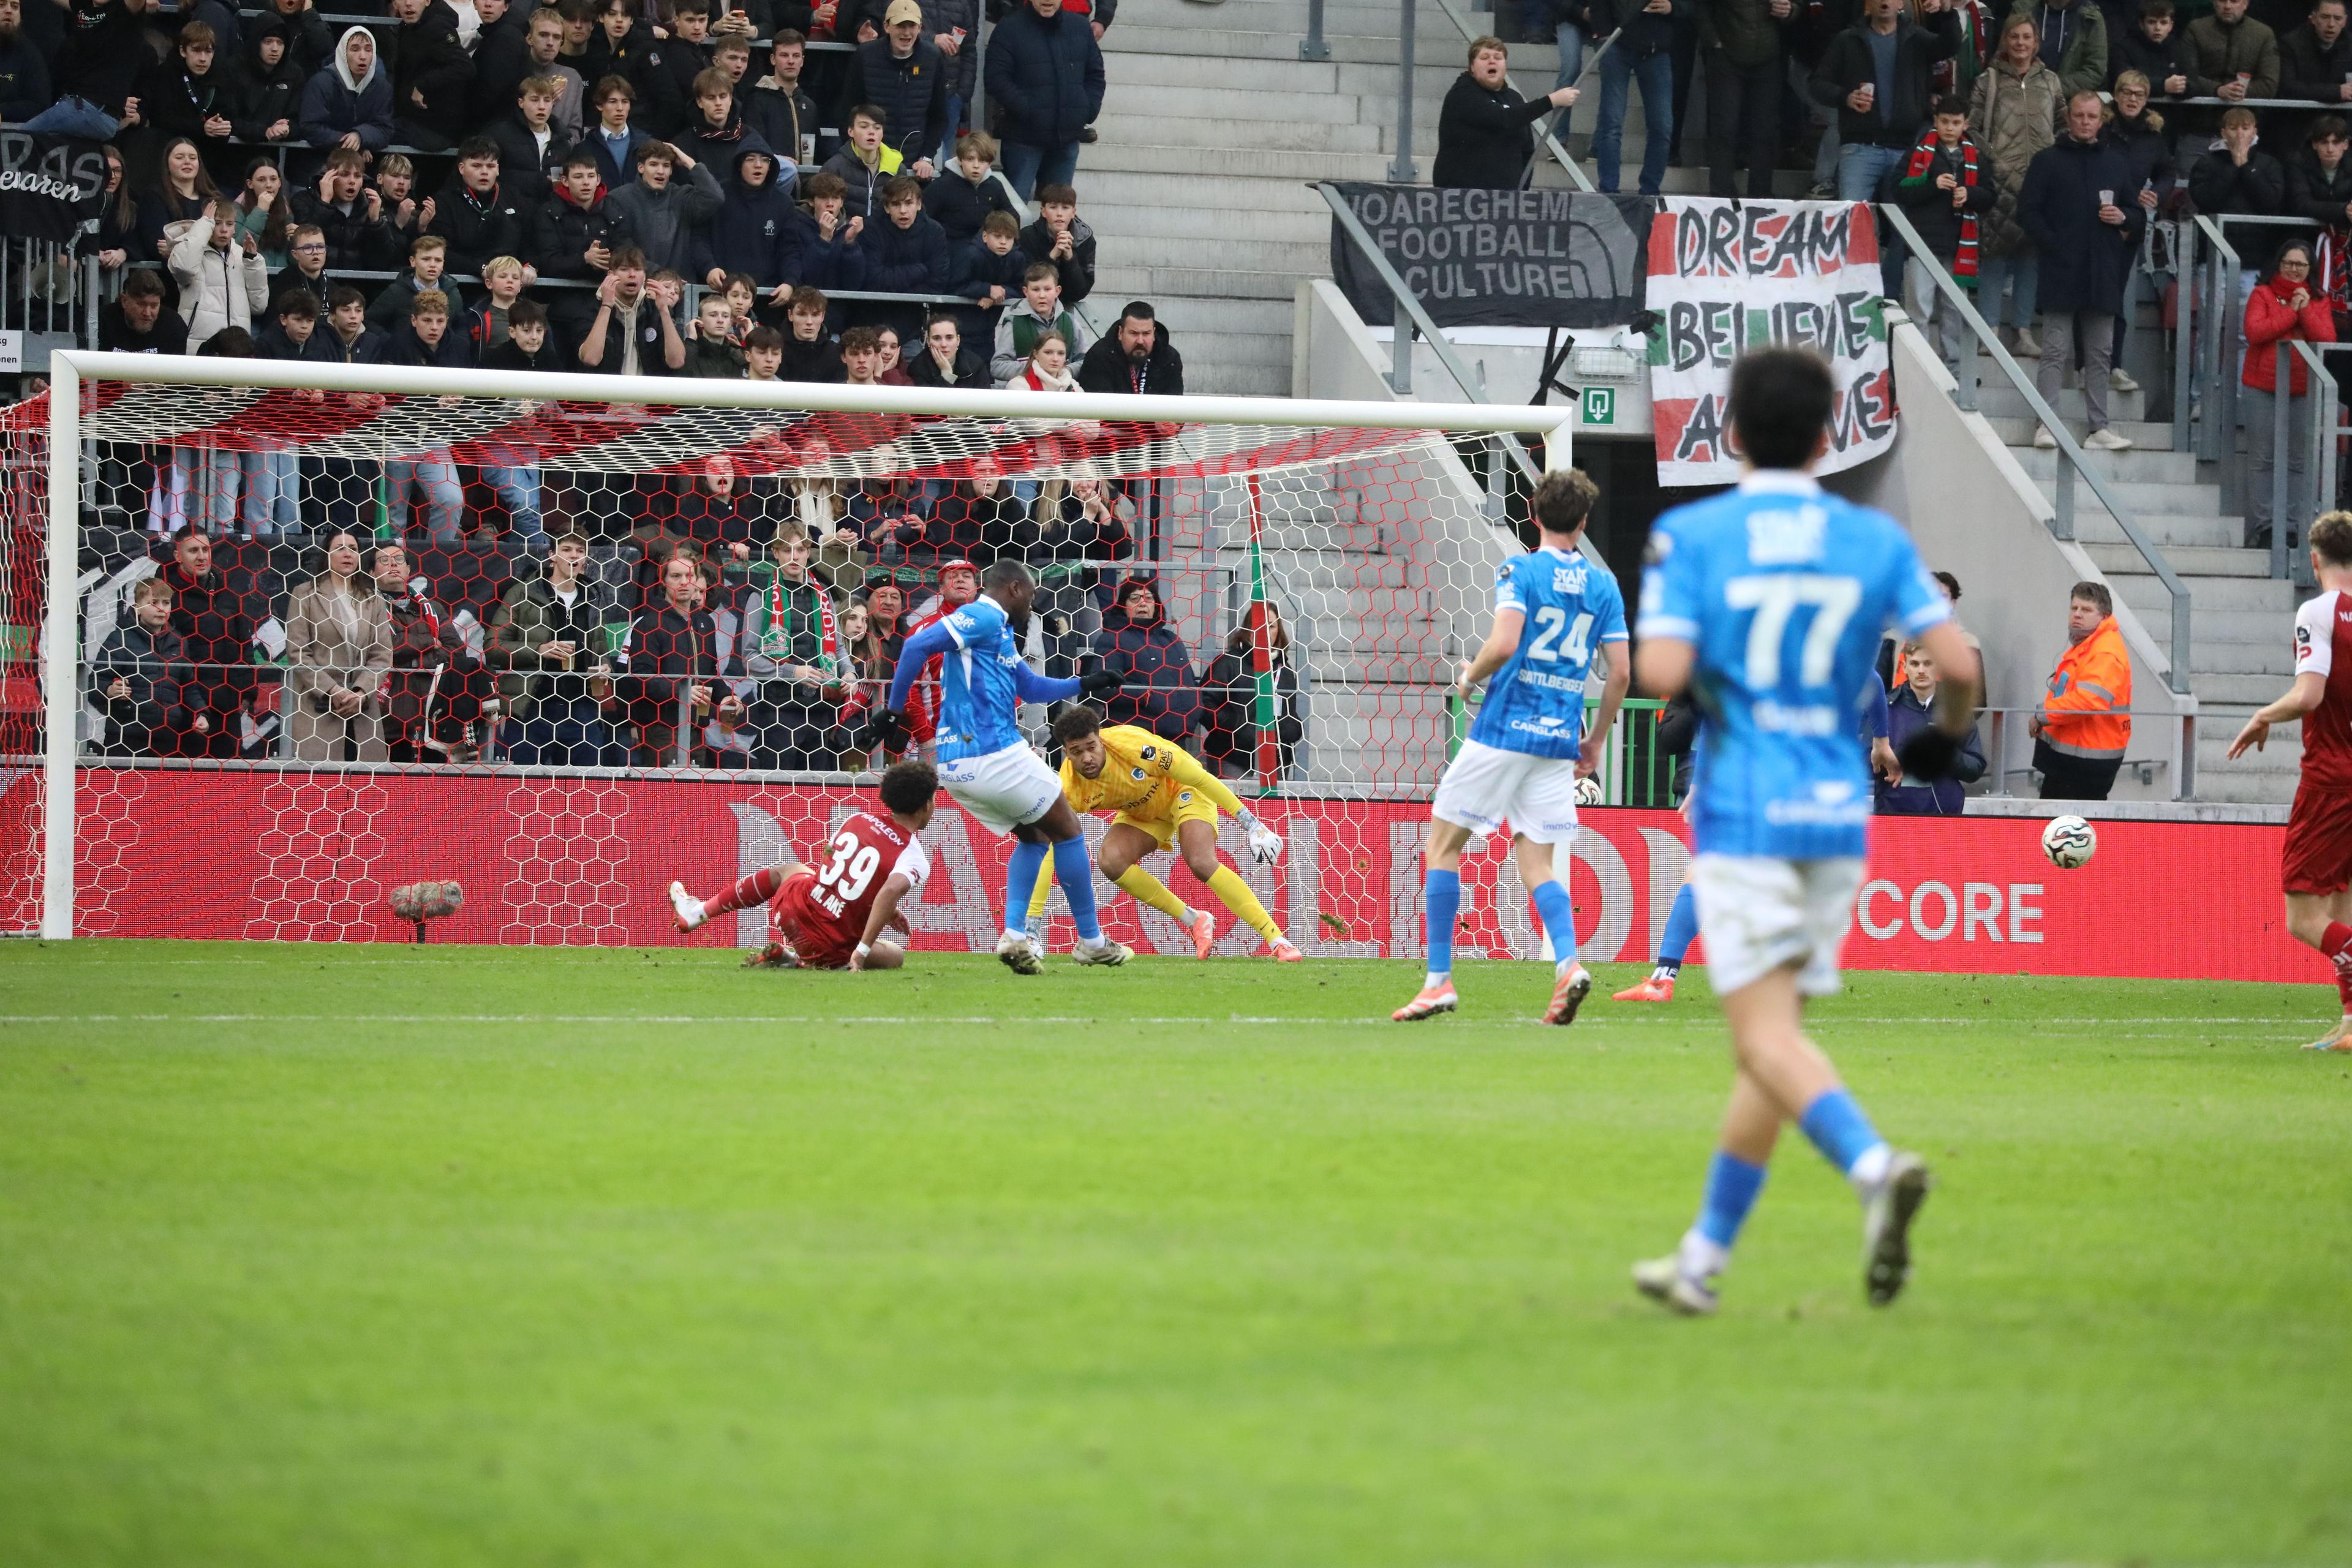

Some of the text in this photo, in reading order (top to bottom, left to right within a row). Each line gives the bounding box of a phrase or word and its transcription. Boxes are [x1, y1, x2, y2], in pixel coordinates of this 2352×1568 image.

[1378, 224, 1569, 260] FOOTBALL
[1677, 205, 1850, 279] DREAM
[1405, 262, 1575, 300] CULTURE
[1526, 606, 1594, 668] 24
[1725, 575, 1862, 692] 77
[1510, 719, 1570, 740] CARGLASS
[861, 813, 904, 846] NAPOLEON
[819, 832, 880, 901] 39
[810, 884, 846, 919] M. AKÉ
[1838, 880, 2045, 943] CORE
